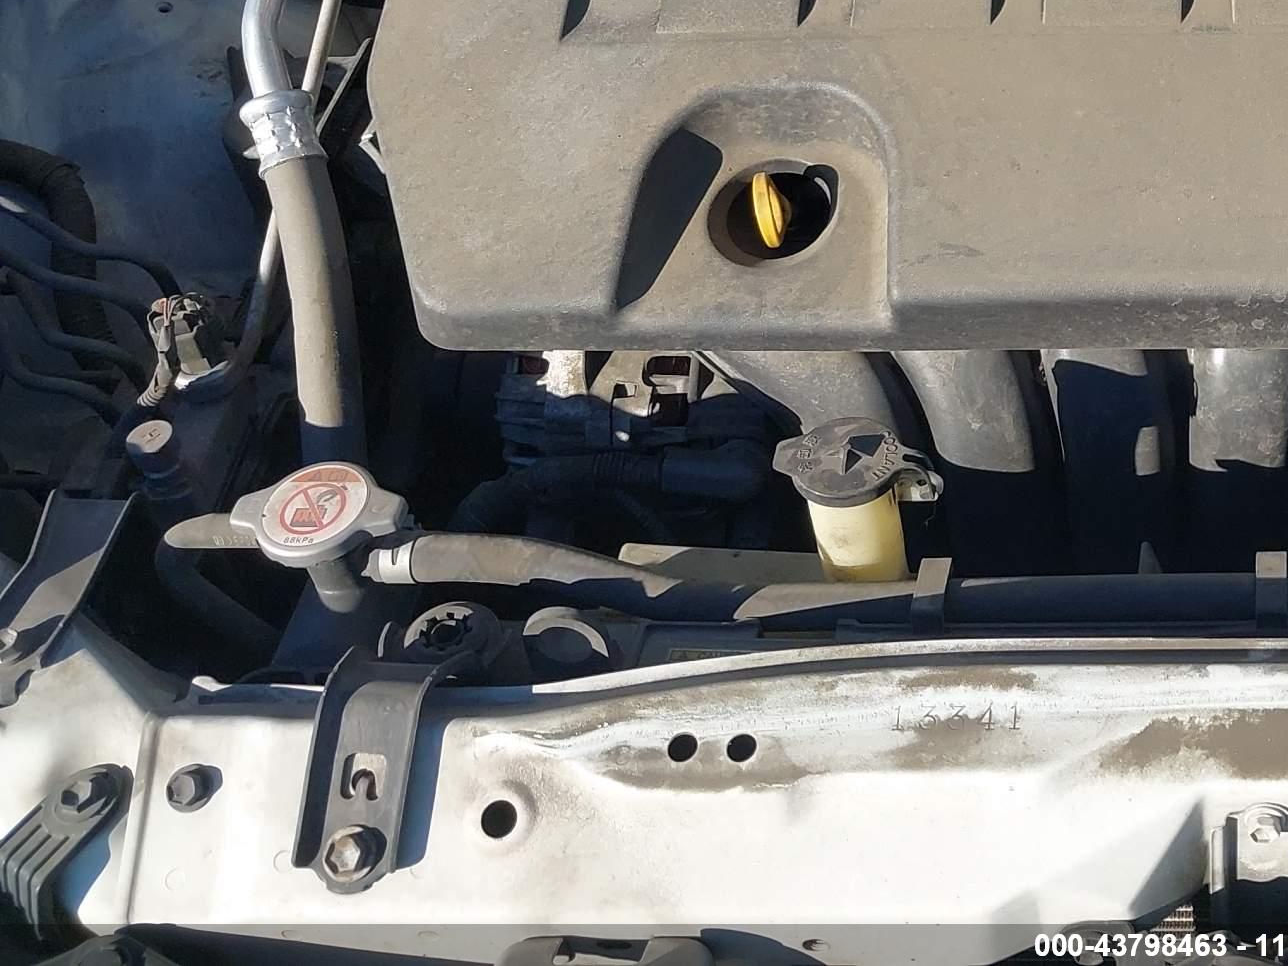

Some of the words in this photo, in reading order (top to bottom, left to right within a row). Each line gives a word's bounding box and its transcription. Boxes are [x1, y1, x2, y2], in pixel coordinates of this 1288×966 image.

[872, 430, 899, 482] COOLANT
[283, 536, 315, 545] 88kPa
[891, 700, 1021, 731] 13341
